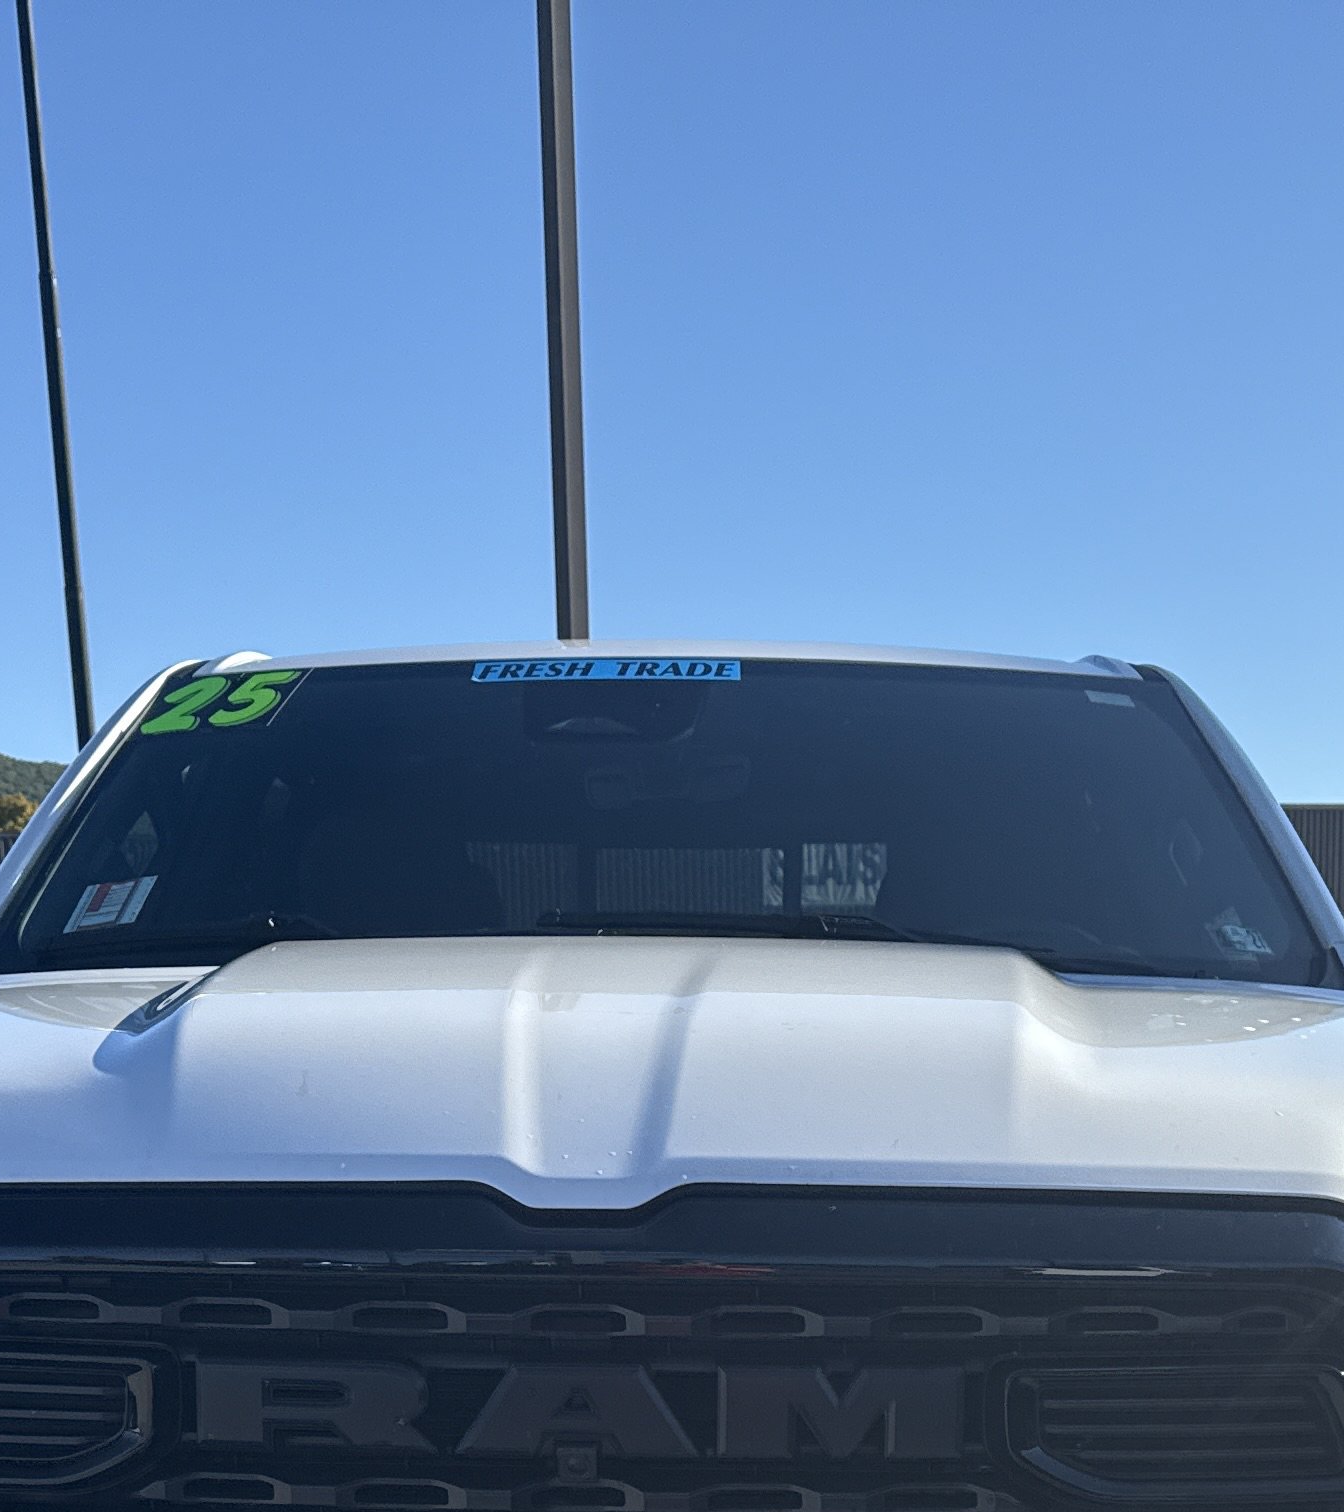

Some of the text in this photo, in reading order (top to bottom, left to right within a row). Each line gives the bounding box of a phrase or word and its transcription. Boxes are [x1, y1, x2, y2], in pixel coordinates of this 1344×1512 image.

[139, 670, 302, 735] 25
[477, 660, 736, 680] FRESH TRADE
[195, 1360, 965, 1461] RAM
